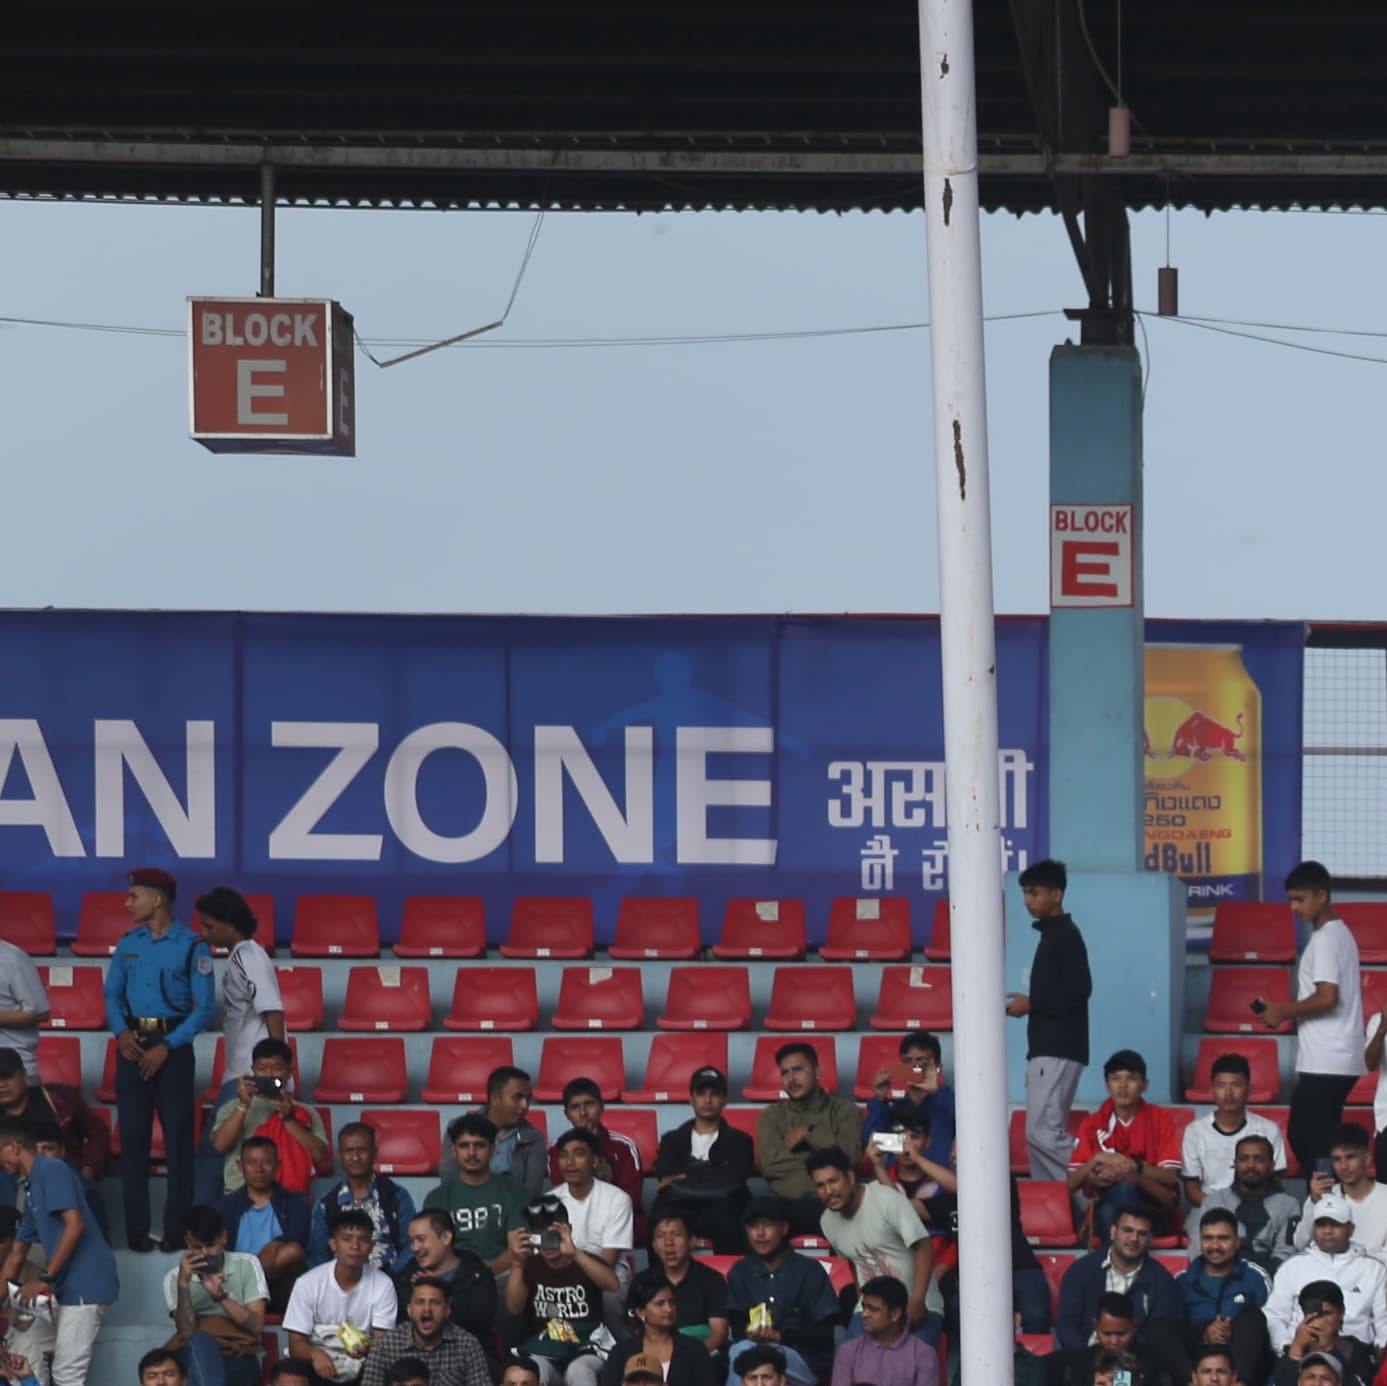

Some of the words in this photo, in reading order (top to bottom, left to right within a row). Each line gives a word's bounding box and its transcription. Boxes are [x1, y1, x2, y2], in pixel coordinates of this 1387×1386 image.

[202, 312, 319, 347] BLOCK
[237, 359, 288, 425] E
[1055, 510, 1128, 534] BLOCK
[1062, 540, 1119, 598] E
[268, 720, 778, 865] ZONE
[827, 748, 1035, 829] असी
[1144, 828, 1232, 841] NGDAENG
[1188, 883, 1235, 897] RINK
[534, 1283, 586, 1303] ASTRO
